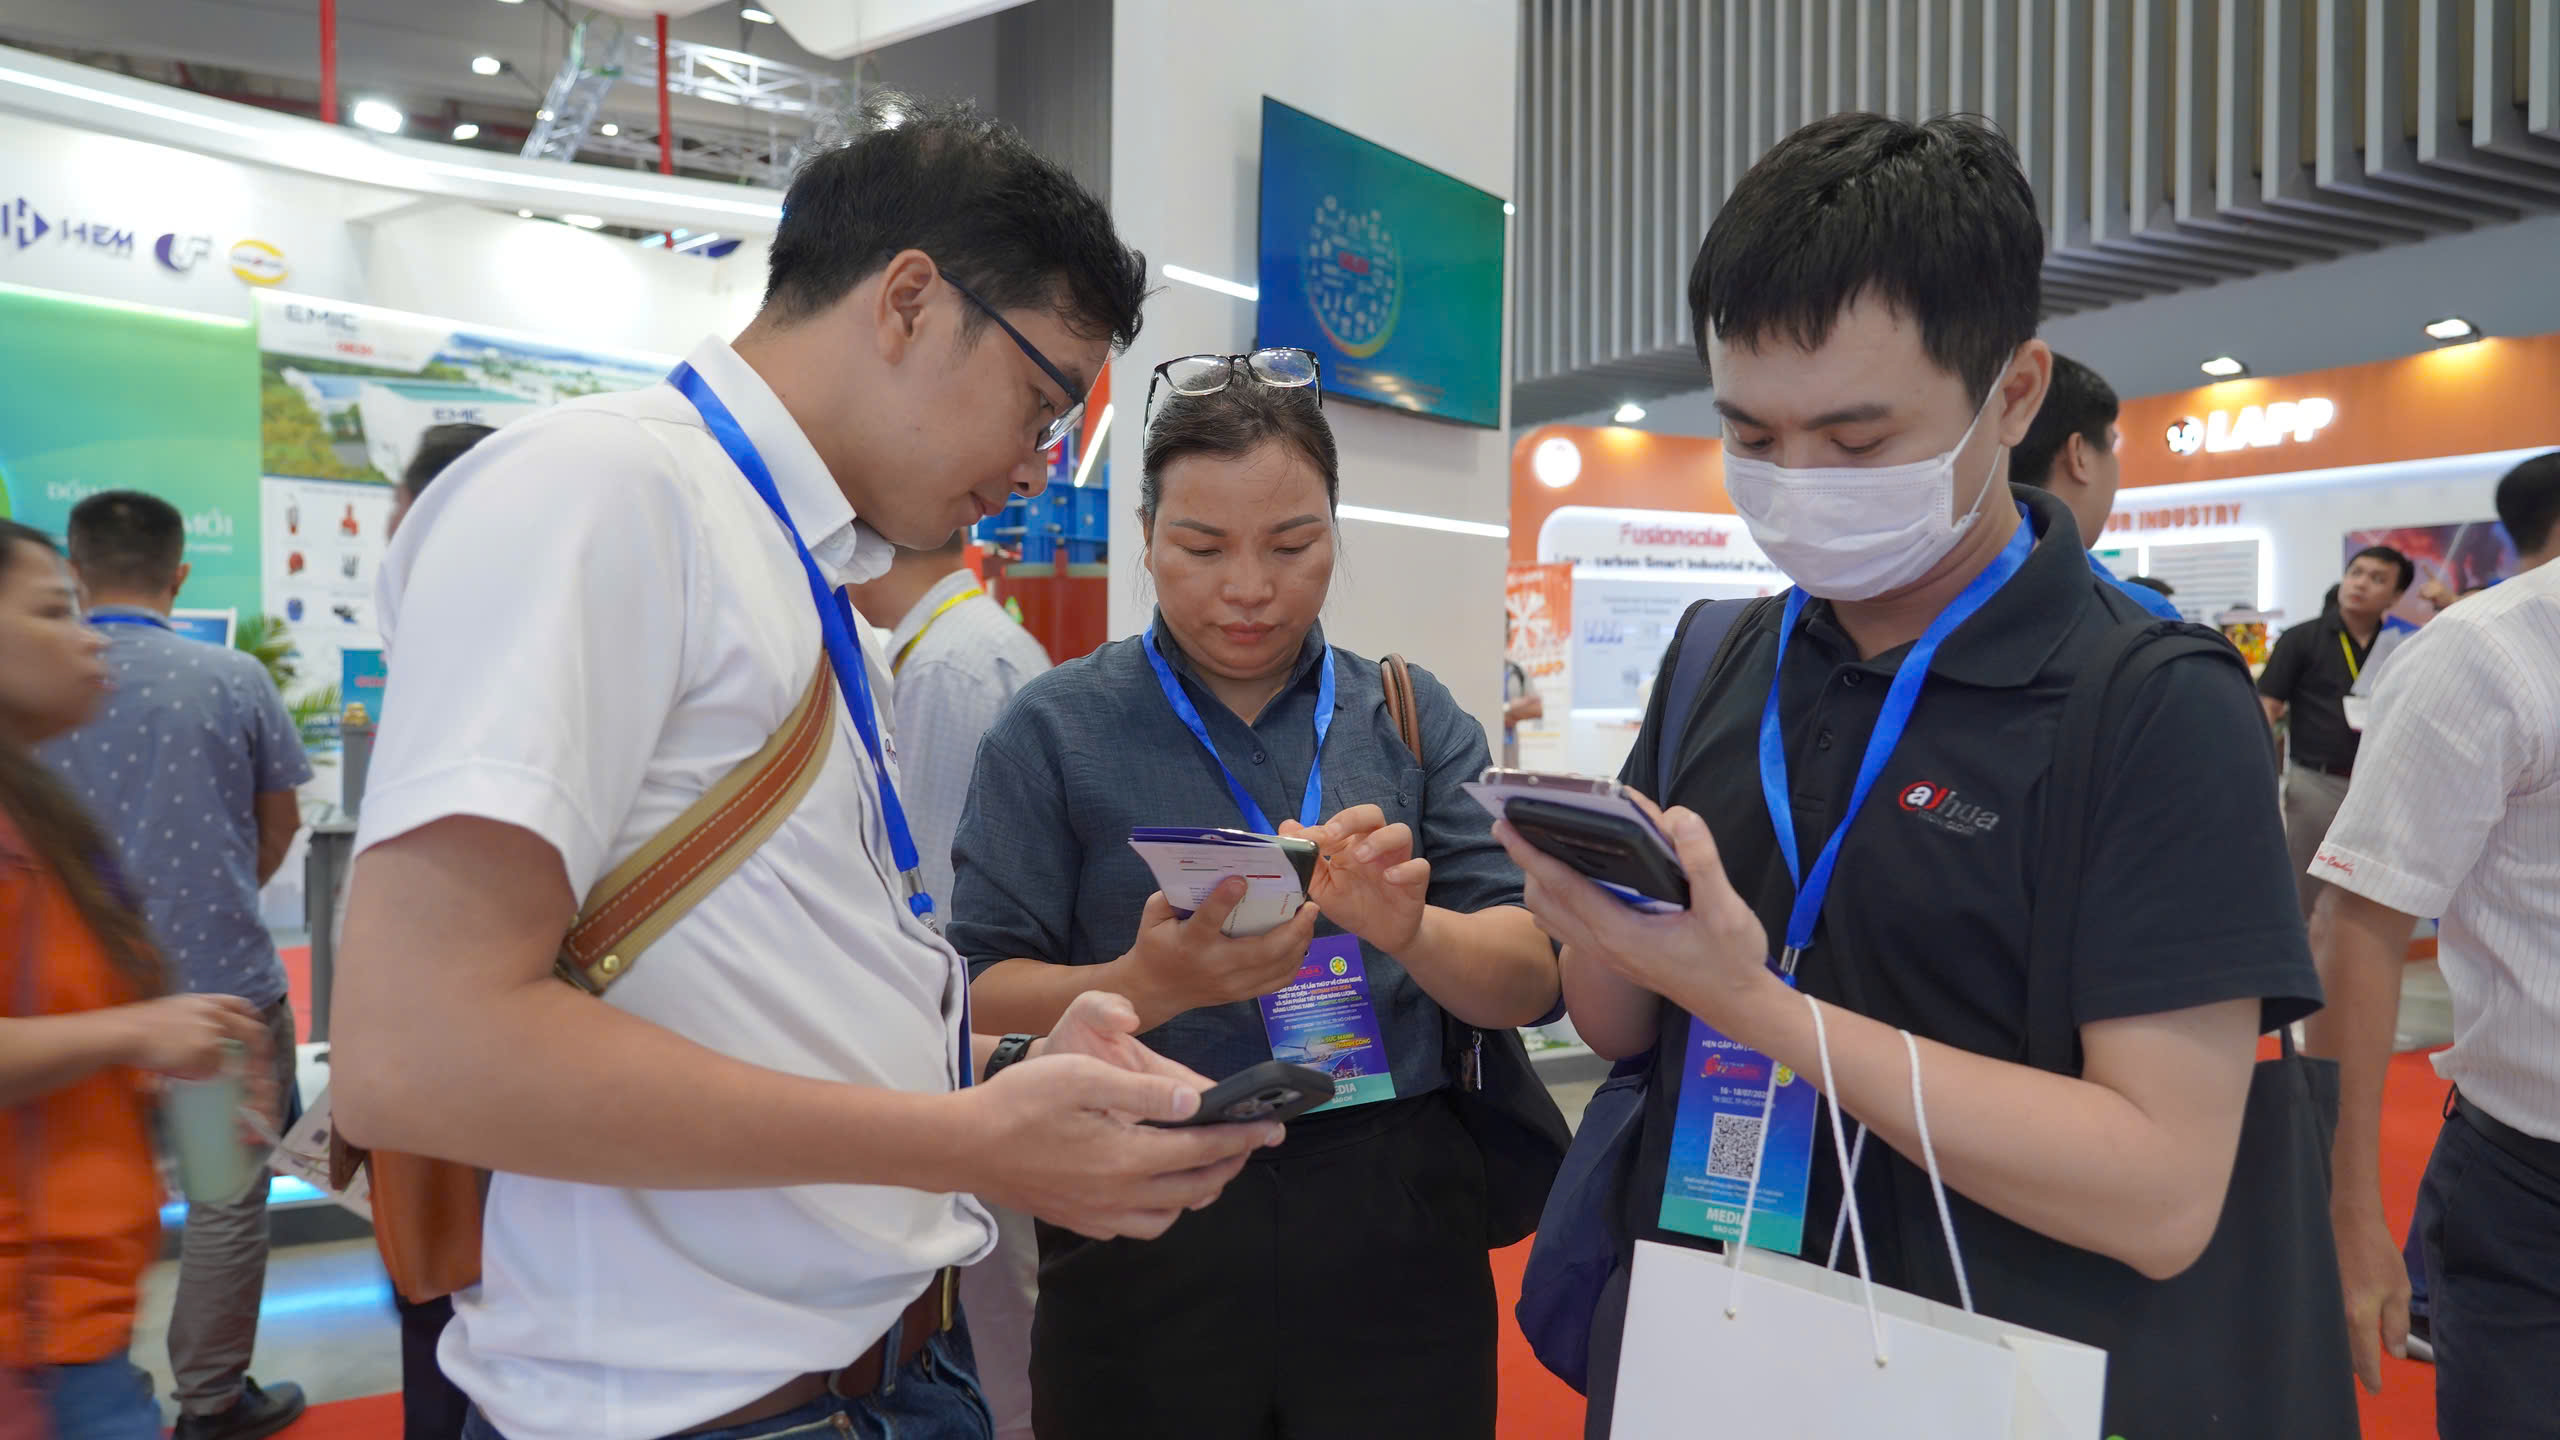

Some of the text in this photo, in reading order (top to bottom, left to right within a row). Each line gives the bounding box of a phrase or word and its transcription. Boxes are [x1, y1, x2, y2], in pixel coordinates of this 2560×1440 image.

[61, 217, 134, 248] HEM
[2204, 397, 2336, 454] LAPP
[2138, 502, 2242, 532] INDUSTRY
[1618, 521, 1732, 548] Fusionsolar
[1645, 554, 1685, 569] Smart
[1333, 1082, 1357, 1095] EDIA
